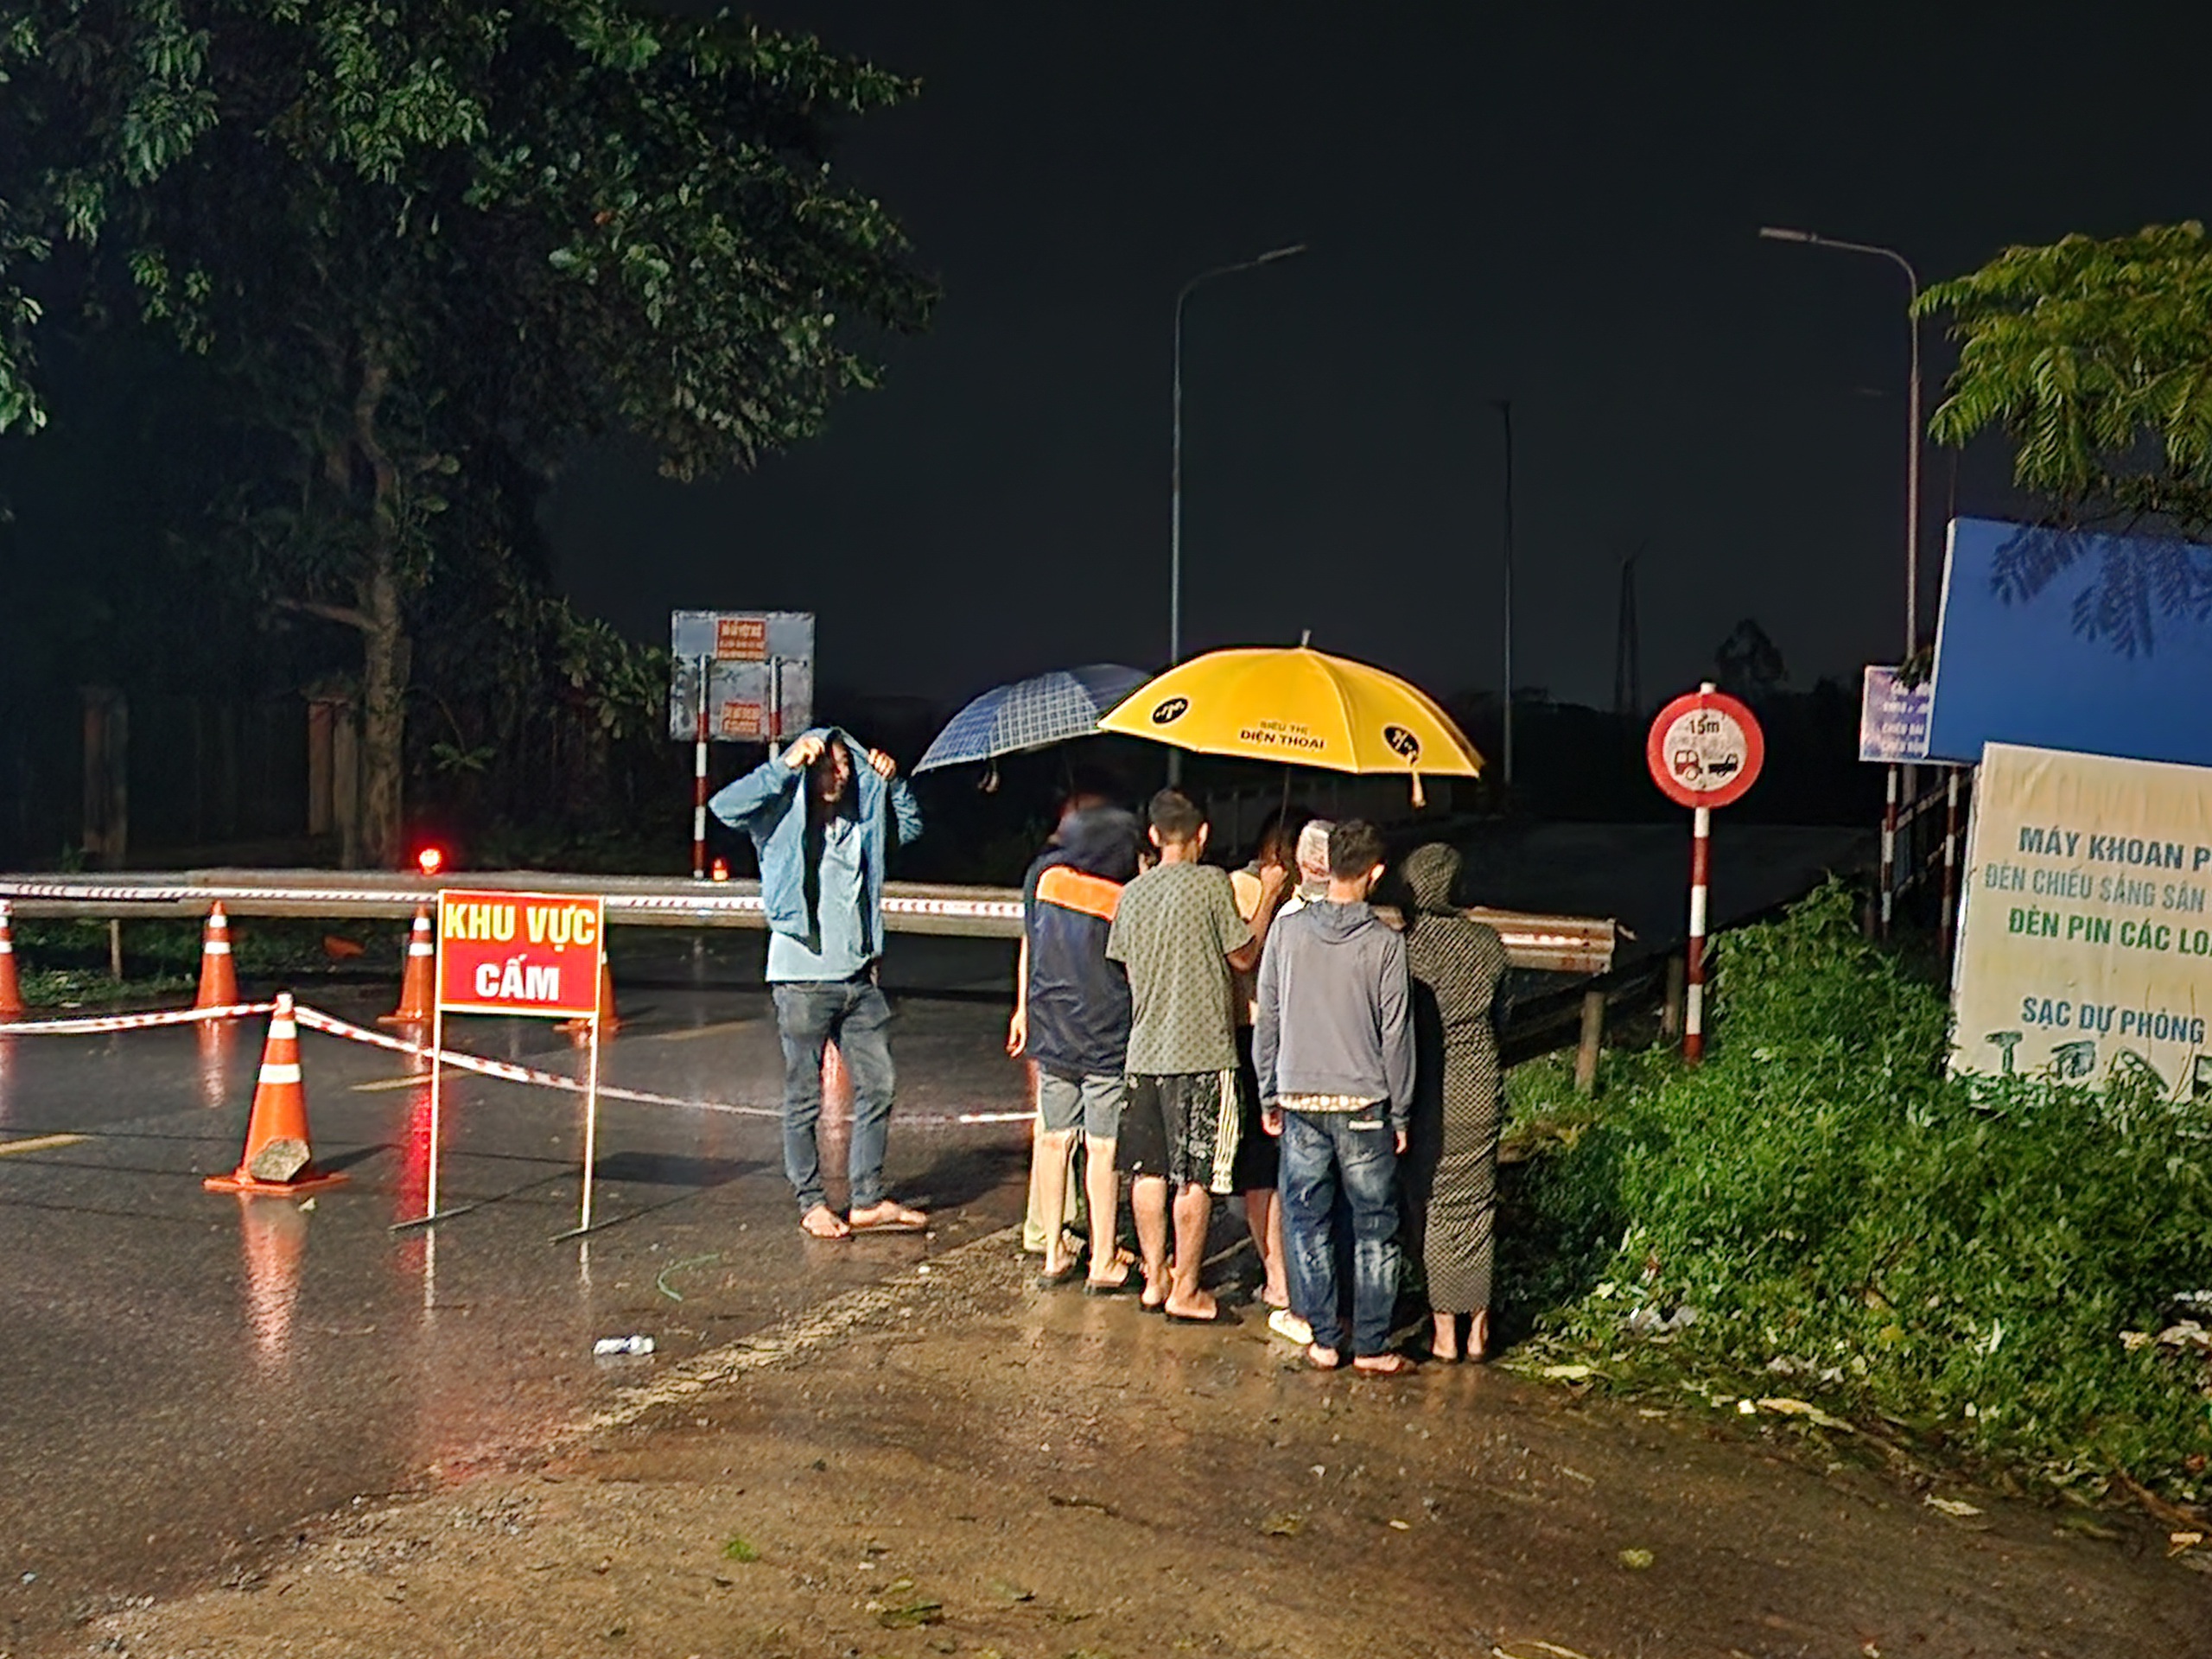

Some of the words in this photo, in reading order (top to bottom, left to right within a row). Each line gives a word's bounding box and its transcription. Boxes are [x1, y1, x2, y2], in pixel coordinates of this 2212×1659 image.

[1280, 734, 1325, 751] THOẠI
[2018, 825, 2081, 857] MÁY
[2088, 834, 2184, 869] KHOAN
[1985, 860, 2026, 891] ĐÈN
[2033, 865, 2094, 899] CHIẾU
[2099, 873, 2156, 907] SÁNG
[444, 903, 516, 941] KHU
[526, 905, 596, 952] VỰC
[2008, 905, 2059, 938] ĐÈN
[2068, 915, 2113, 944] PIN
[2120, 918, 2171, 951] CÁC
[474, 953, 560, 1001] CẤM
[2021, 996, 2072, 1030] SẠC
[2078, 1003, 2117, 1039] DỰ
[2120, 1007, 2206, 1045] PHÒNG
